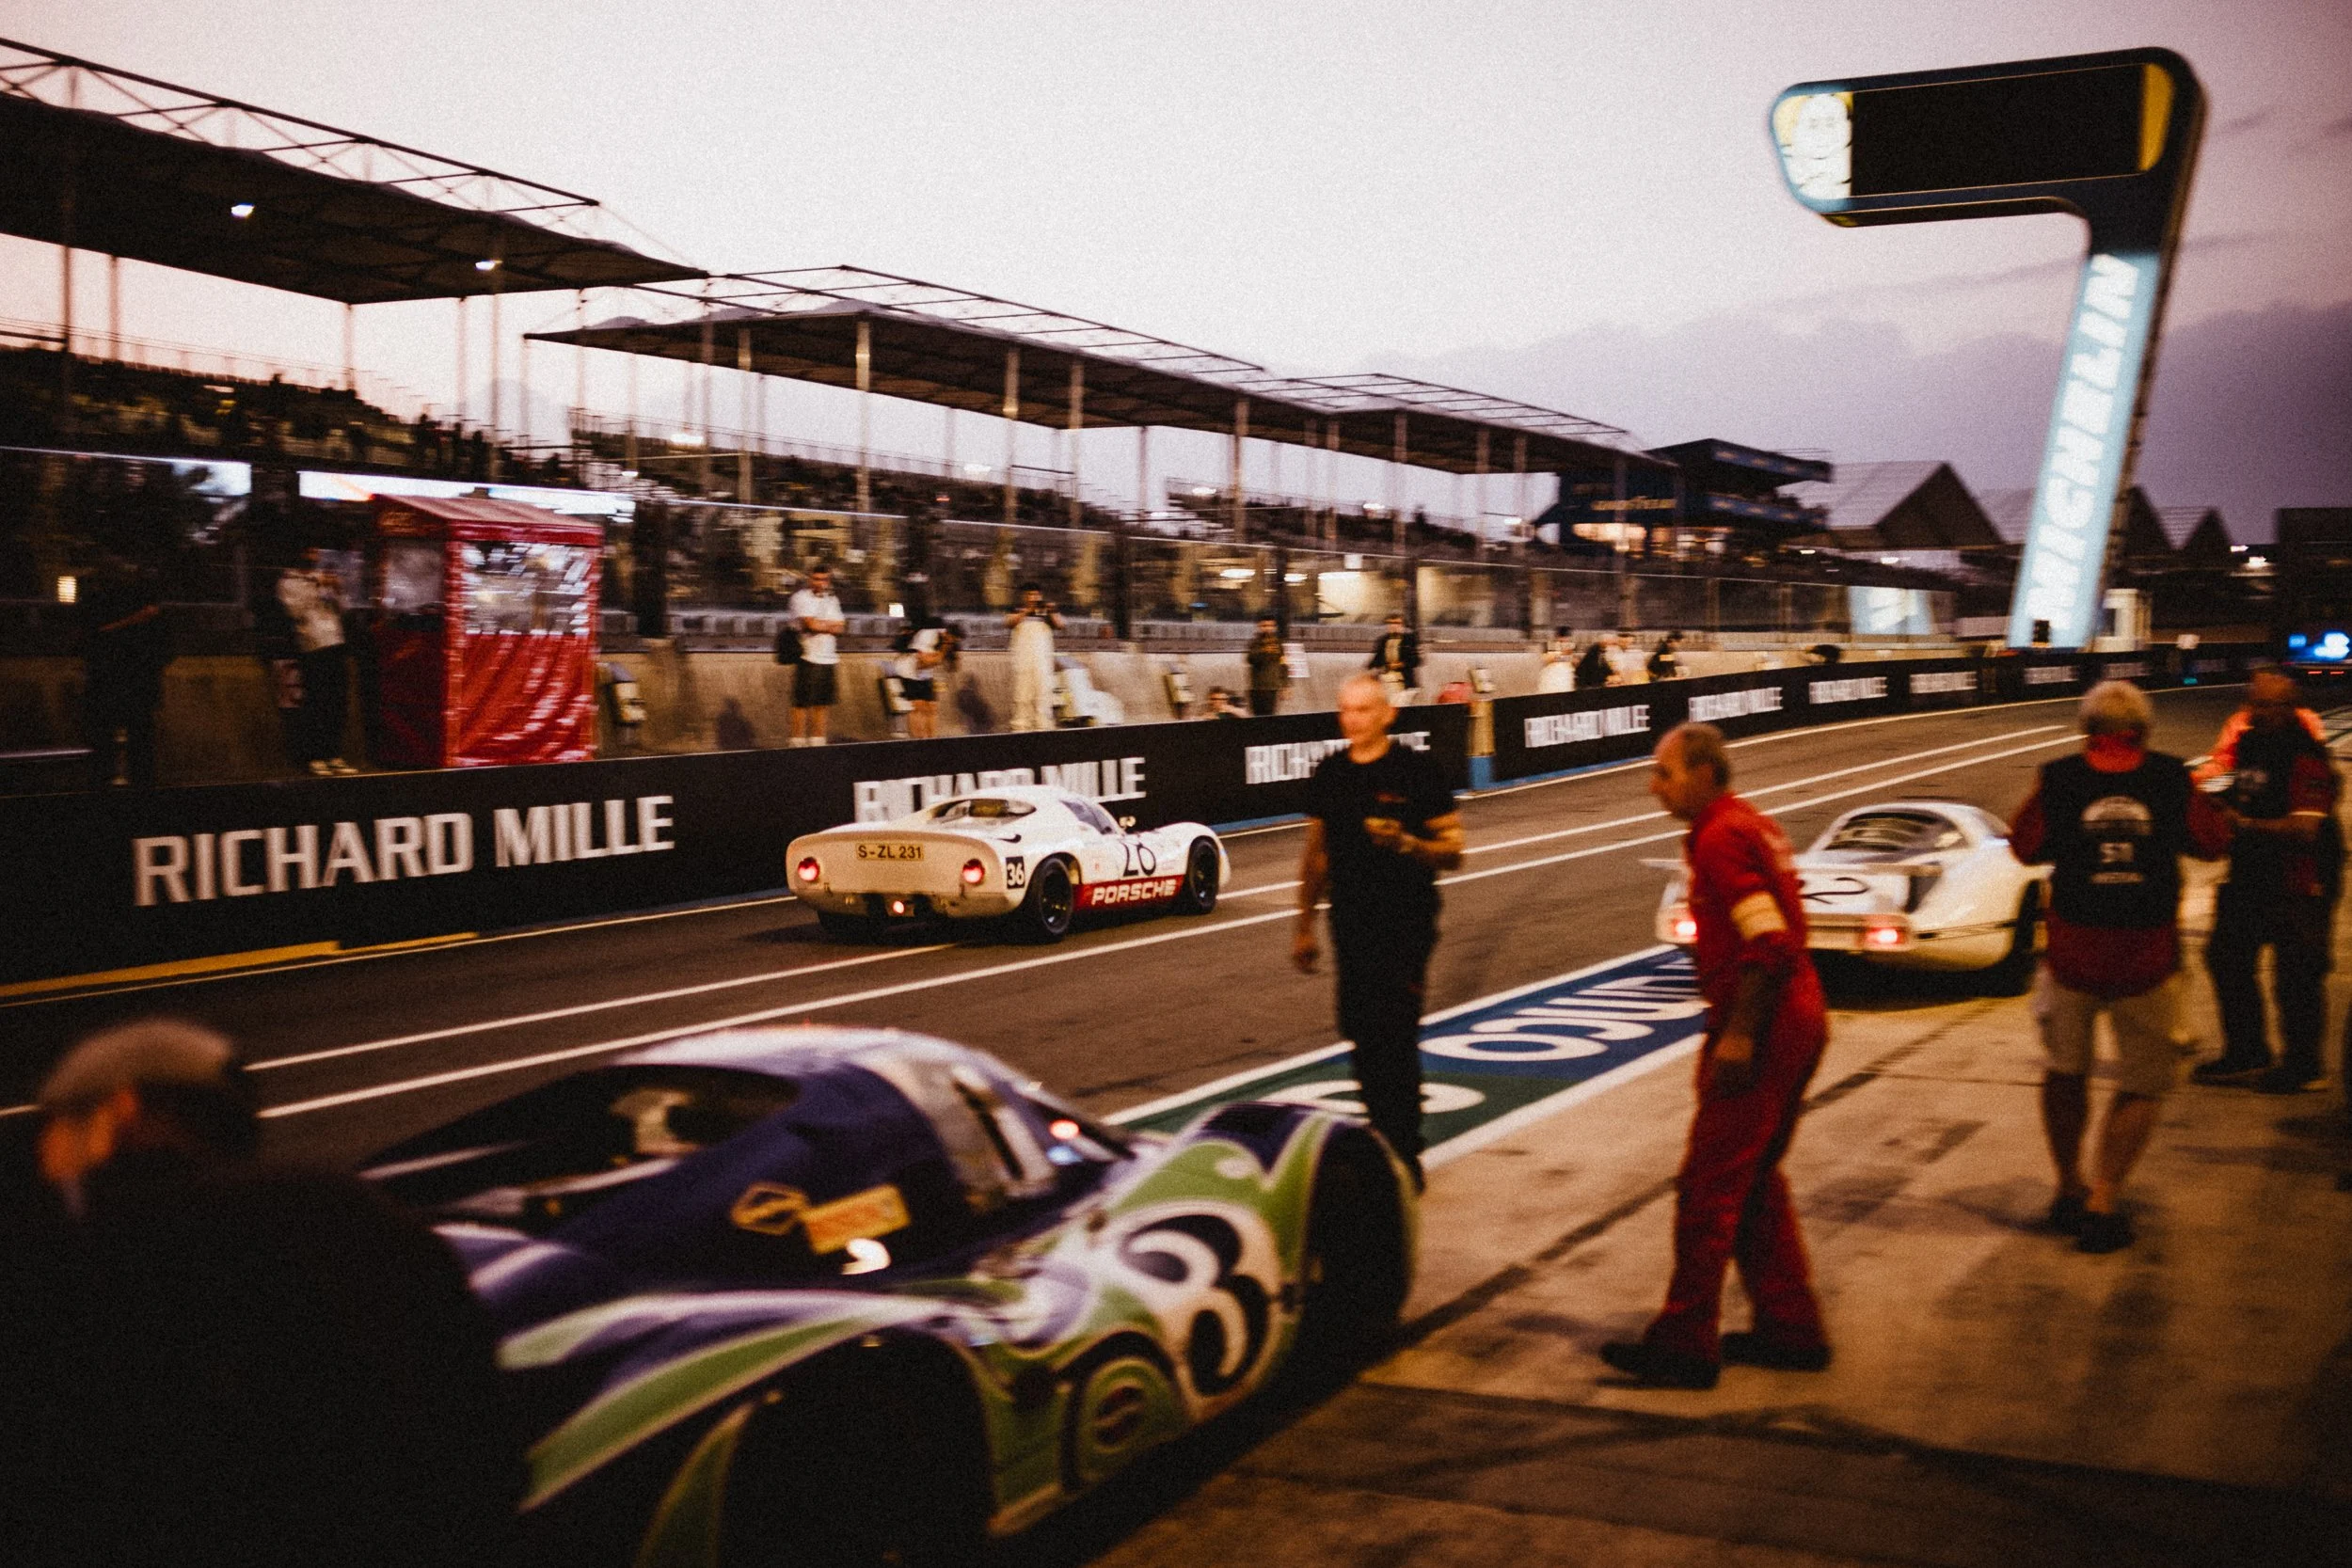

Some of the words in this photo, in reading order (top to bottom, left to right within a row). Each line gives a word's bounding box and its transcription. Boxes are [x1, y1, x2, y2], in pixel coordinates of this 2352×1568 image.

[1245, 738, 1353, 784] RICH
[133, 813, 474, 907] RICHARD
[493, 795, 675, 868] MILLE
[898, 846, 922, 859] 231
[1007, 863, 1025, 887] 36
[1091, 879, 1177, 906] PORSCHE
[1120, 1213, 1268, 1397] 3
